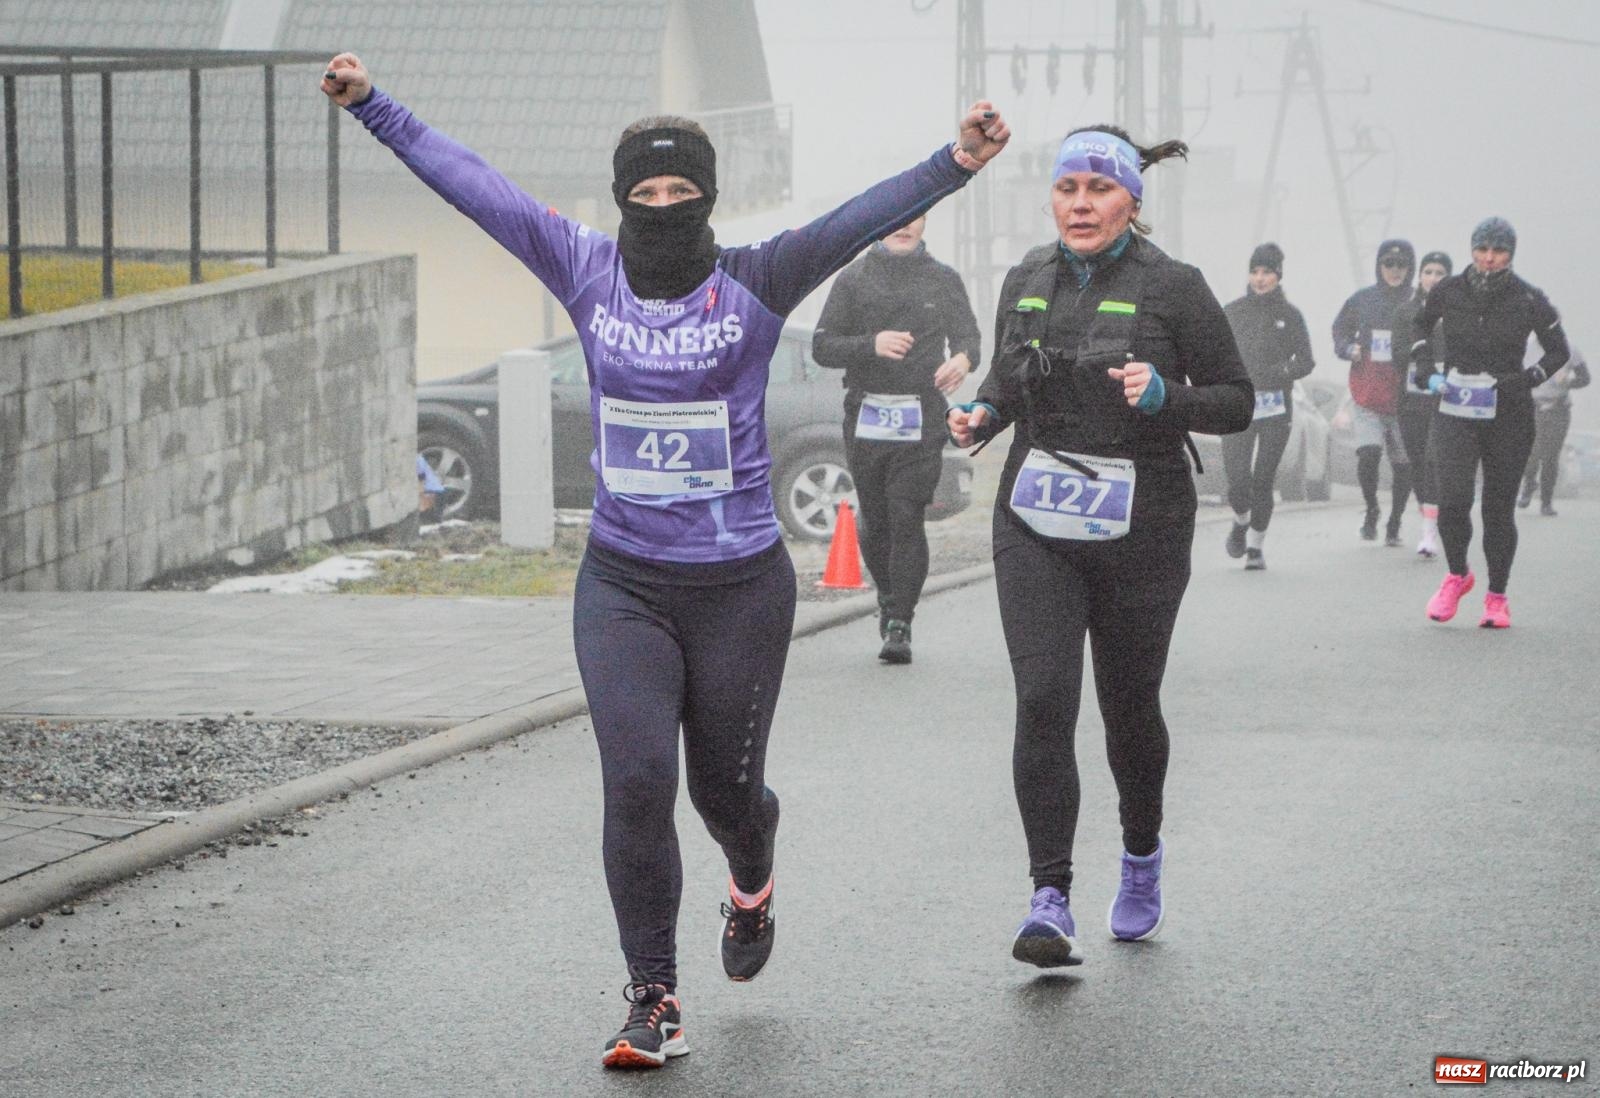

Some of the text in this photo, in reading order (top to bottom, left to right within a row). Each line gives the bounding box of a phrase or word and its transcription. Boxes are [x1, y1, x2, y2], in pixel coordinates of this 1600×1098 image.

[1078, 142, 1106, 152] EKO
[589, 303, 743, 355] RUNNERS
[678, 357, 718, 371] TEAM
[1459, 387, 1472, 405] 9
[879, 408, 903, 428] 98
[636, 431, 691, 469] 42
[1035, 474, 1111, 515] 127
